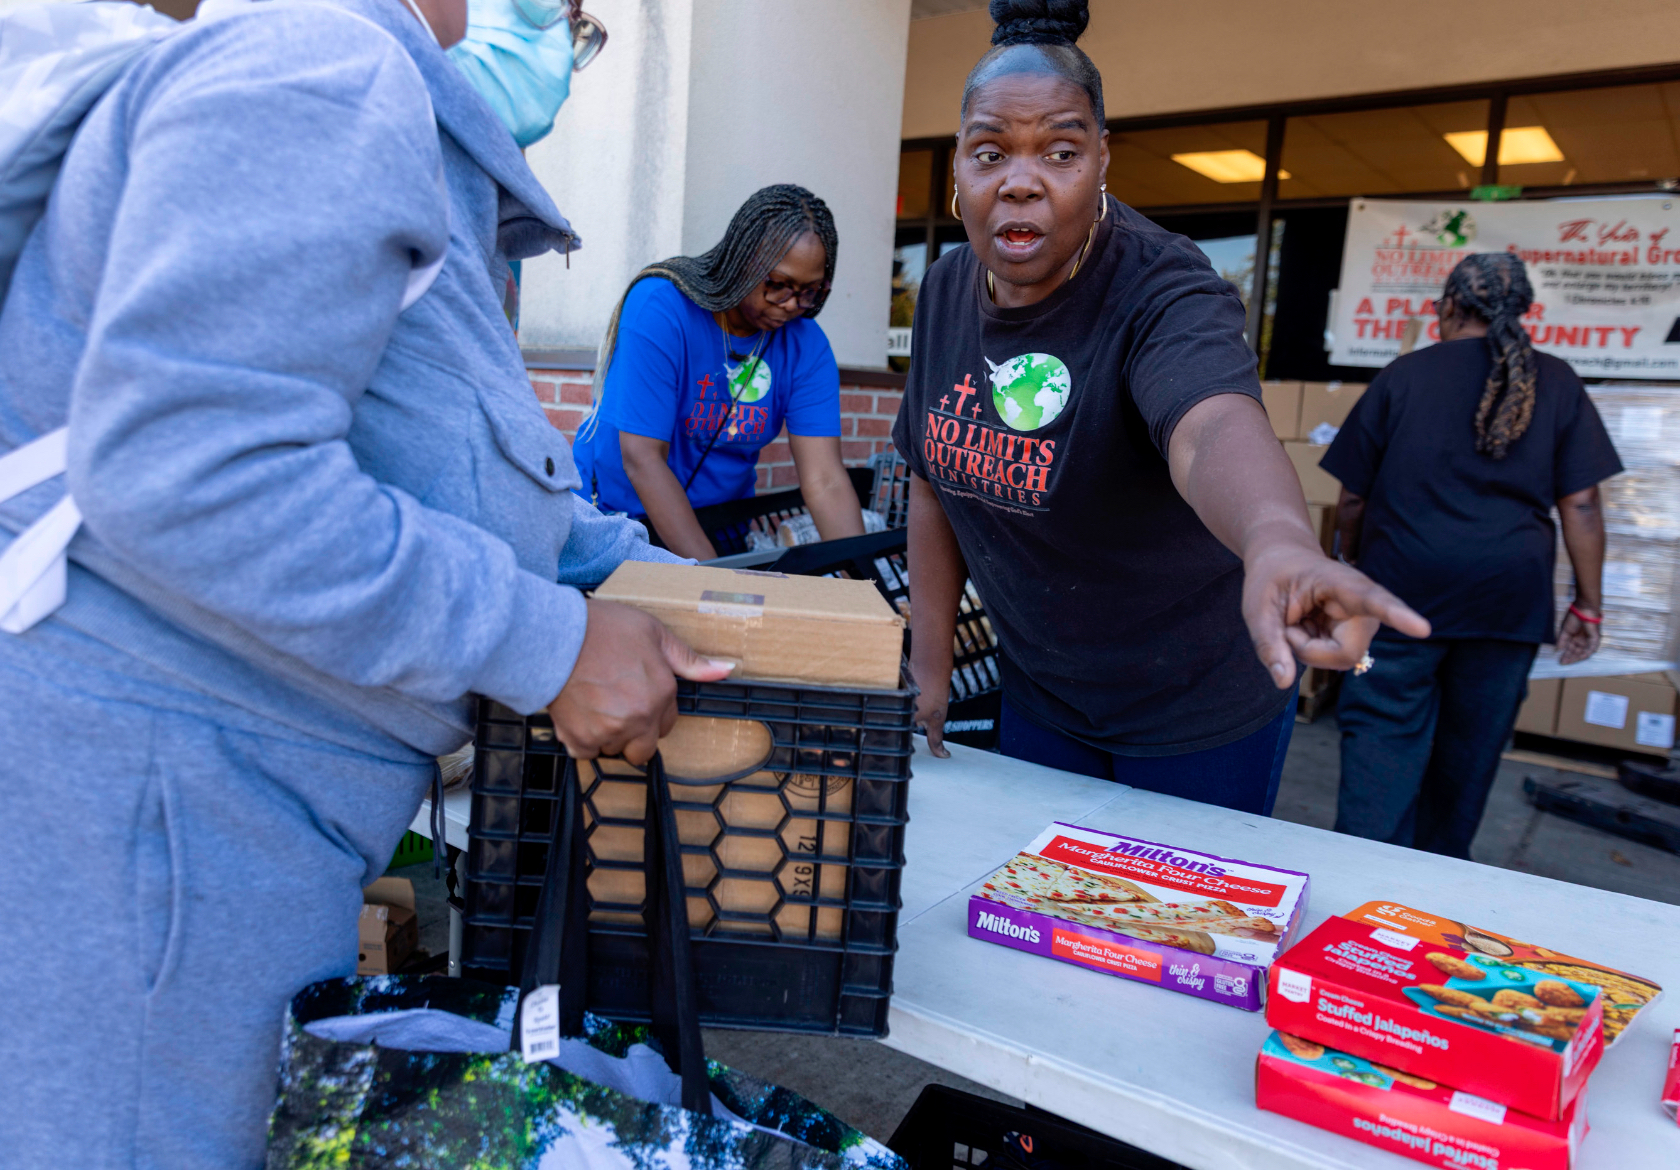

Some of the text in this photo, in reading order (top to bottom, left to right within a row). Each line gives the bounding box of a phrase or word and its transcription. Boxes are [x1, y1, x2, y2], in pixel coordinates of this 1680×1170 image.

[1557, 218, 1596, 243] The
[1648, 227, 1670, 246] of
[1371, 263, 1456, 278] OUTREA
[1407, 249, 1474, 264] LIMIT
[1355, 297, 1438, 316] A PLA
[925, 412, 1056, 466] NO LIMITS
[924, 438, 1052, 492] OUTREACH
[928, 461, 1041, 506] MINISTRIES
[1057, 842, 1155, 871] Margherita
[1158, 864, 1203, 881] Four
[1203, 876, 1272, 896] Cheese
[1089, 857, 1228, 894] CAULIFLOWER CRUST PIZZA
[1103, 841, 1228, 877] Milton's
[975, 910, 1041, 944] Milton's
[1055, 935, 1158, 969] Margherita Four Cheese
[1072, 949, 1138, 972] CAULIFLOWER CRUST PIZZA
[1322, 944, 1417, 980] Jalapeños
[1338, 942, 1411, 971] Stuffed
[1169, 963, 1189, 977] thin
[1189, 963, 1200, 977] &
[1177, 972, 1206, 991] crispy
[1319, 988, 1341, 1001] Cream
[1315, 1012, 1345, 1028] Coated
[1345, 1021, 1353, 1031] in
[1360, 1027, 1386, 1043] Crispy
[1386, 1033, 1423, 1055] Breading
[1317, 997, 1374, 1027] Stuffed
[1374, 1015, 1450, 1051] Jalapeños
[1352, 1116, 1499, 1170] Stuffed Jalapeños
